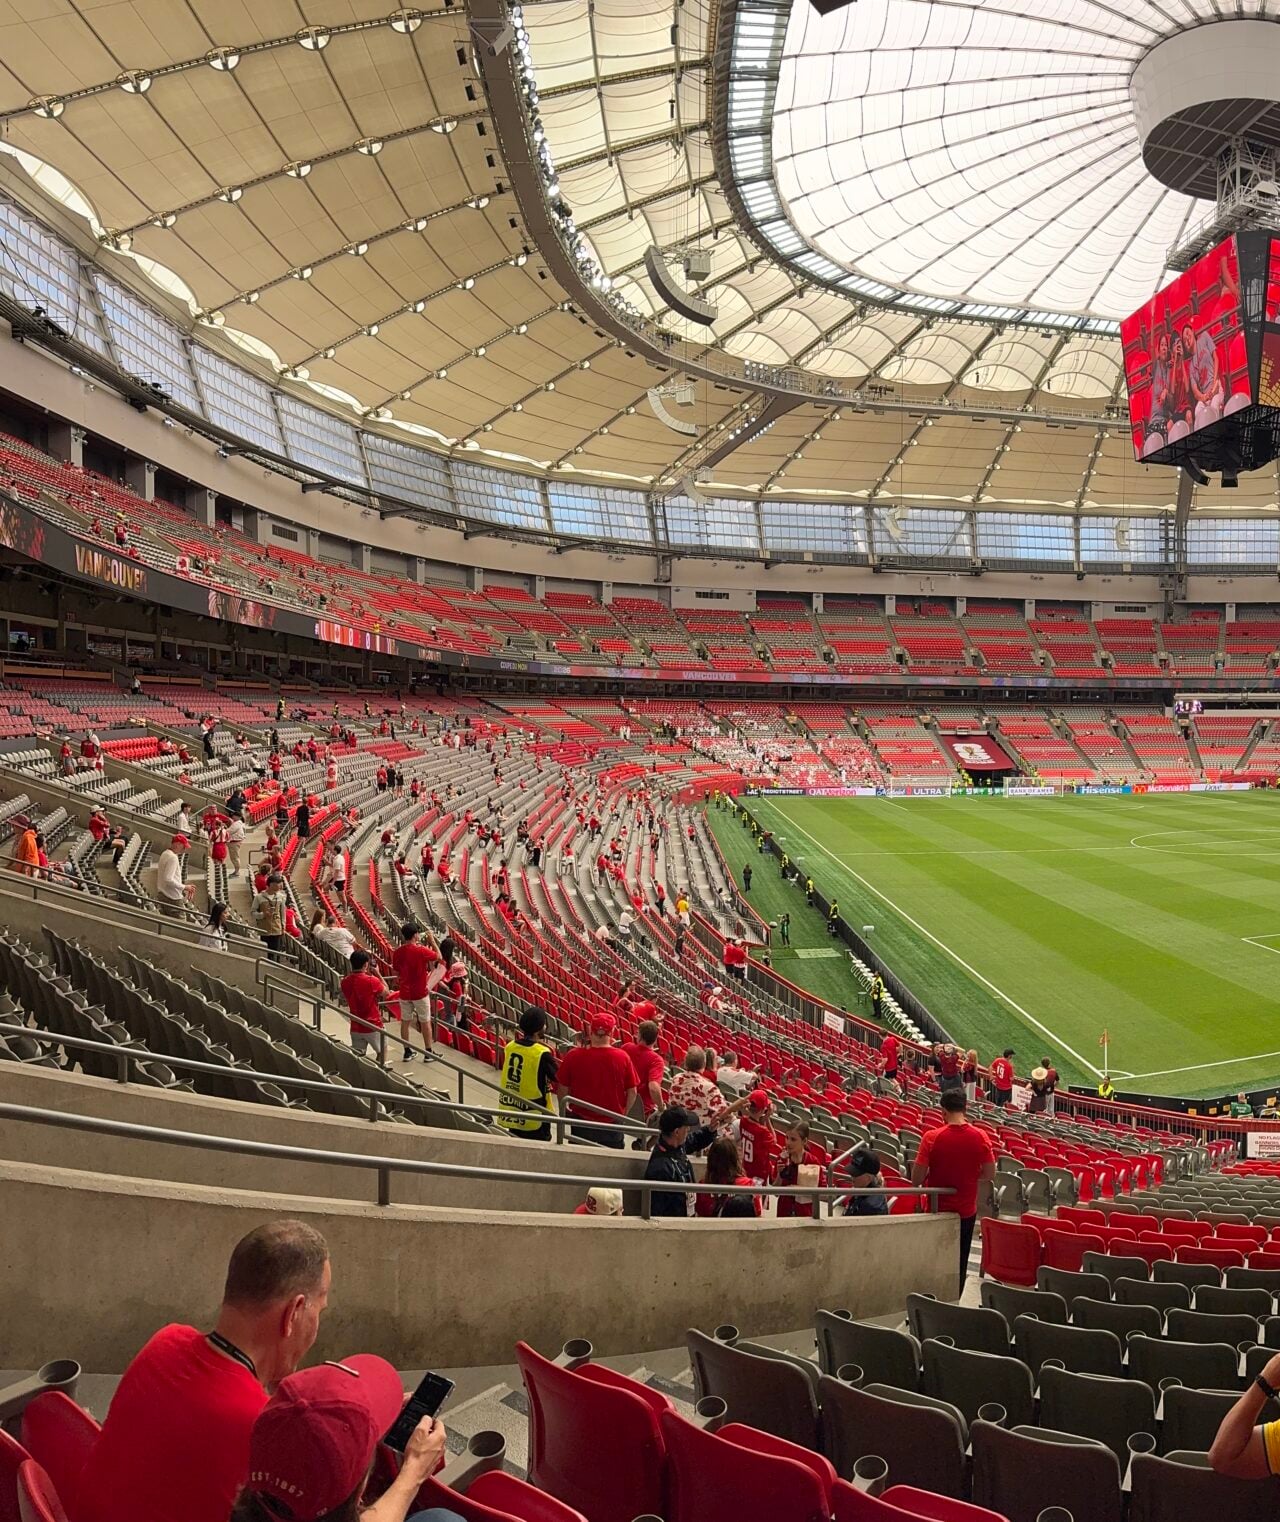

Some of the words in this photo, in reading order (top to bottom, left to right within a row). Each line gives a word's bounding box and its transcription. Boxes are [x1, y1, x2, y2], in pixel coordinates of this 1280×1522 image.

[913, 787, 942, 795] ULTRA
[1081, 785, 1122, 794] Hisense
[1147, 784, 1189, 792] McDonald's
[741, 1136, 754, 1163] 19
